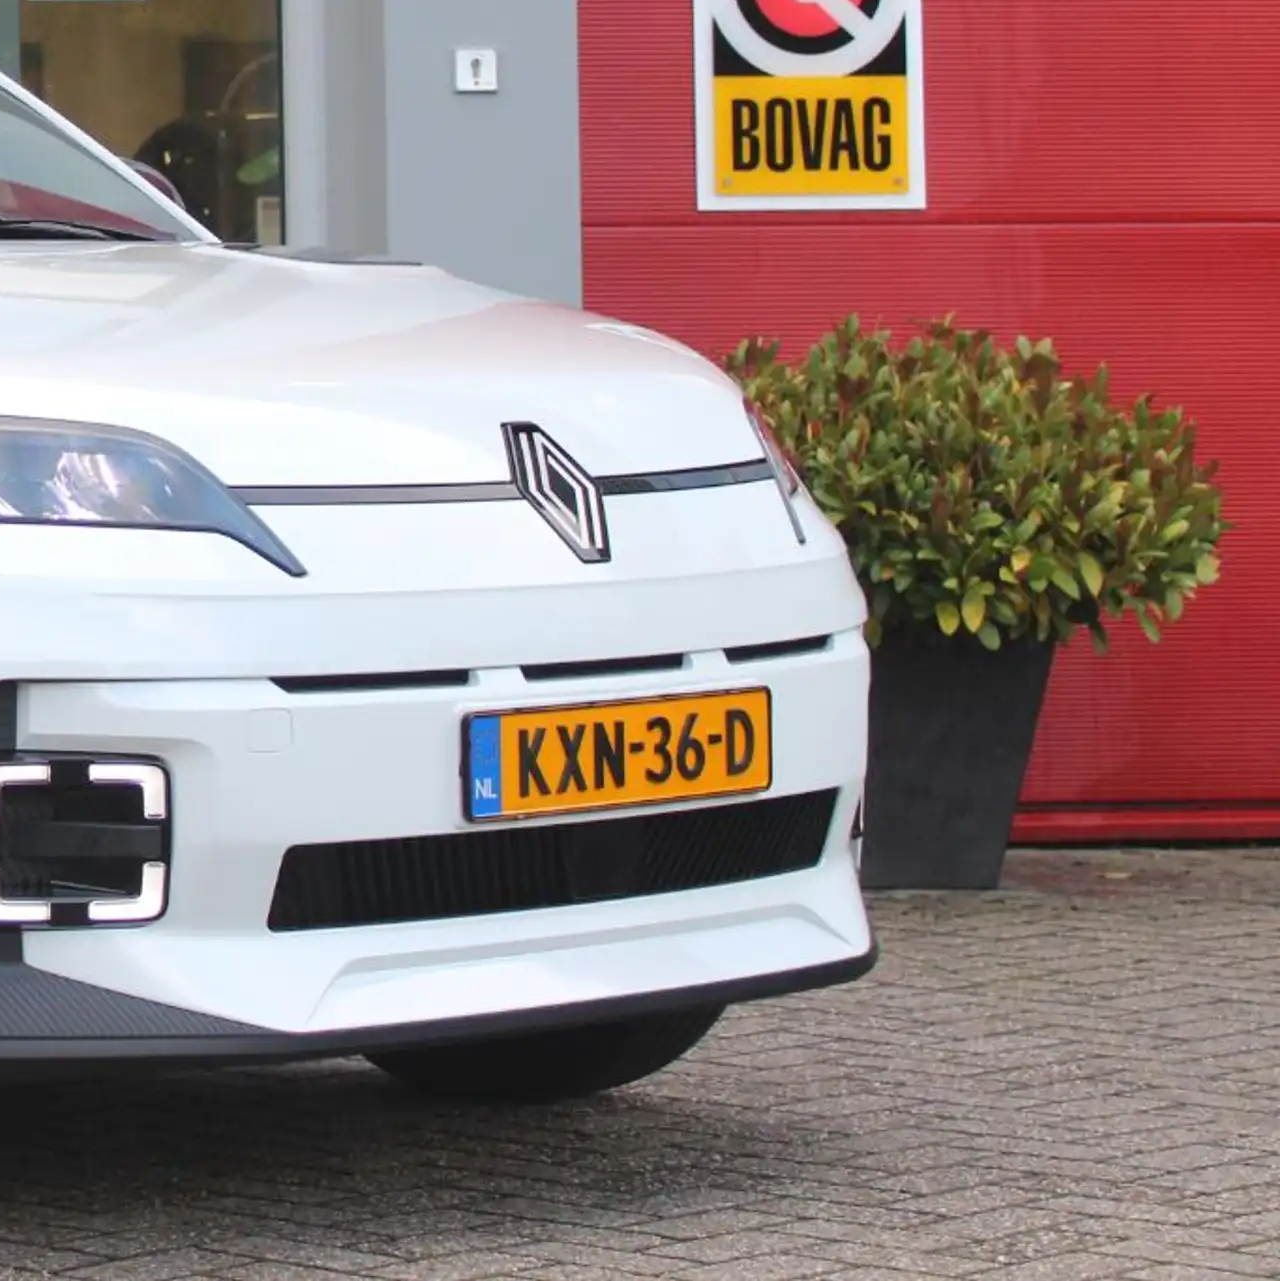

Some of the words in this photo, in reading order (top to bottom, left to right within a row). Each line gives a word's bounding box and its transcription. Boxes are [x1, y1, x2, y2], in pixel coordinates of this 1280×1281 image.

[730, 96, 893, 173] BOVAG
[474, 777, 498, 801] NL
[517, 708, 755, 799] KXN-36-D
